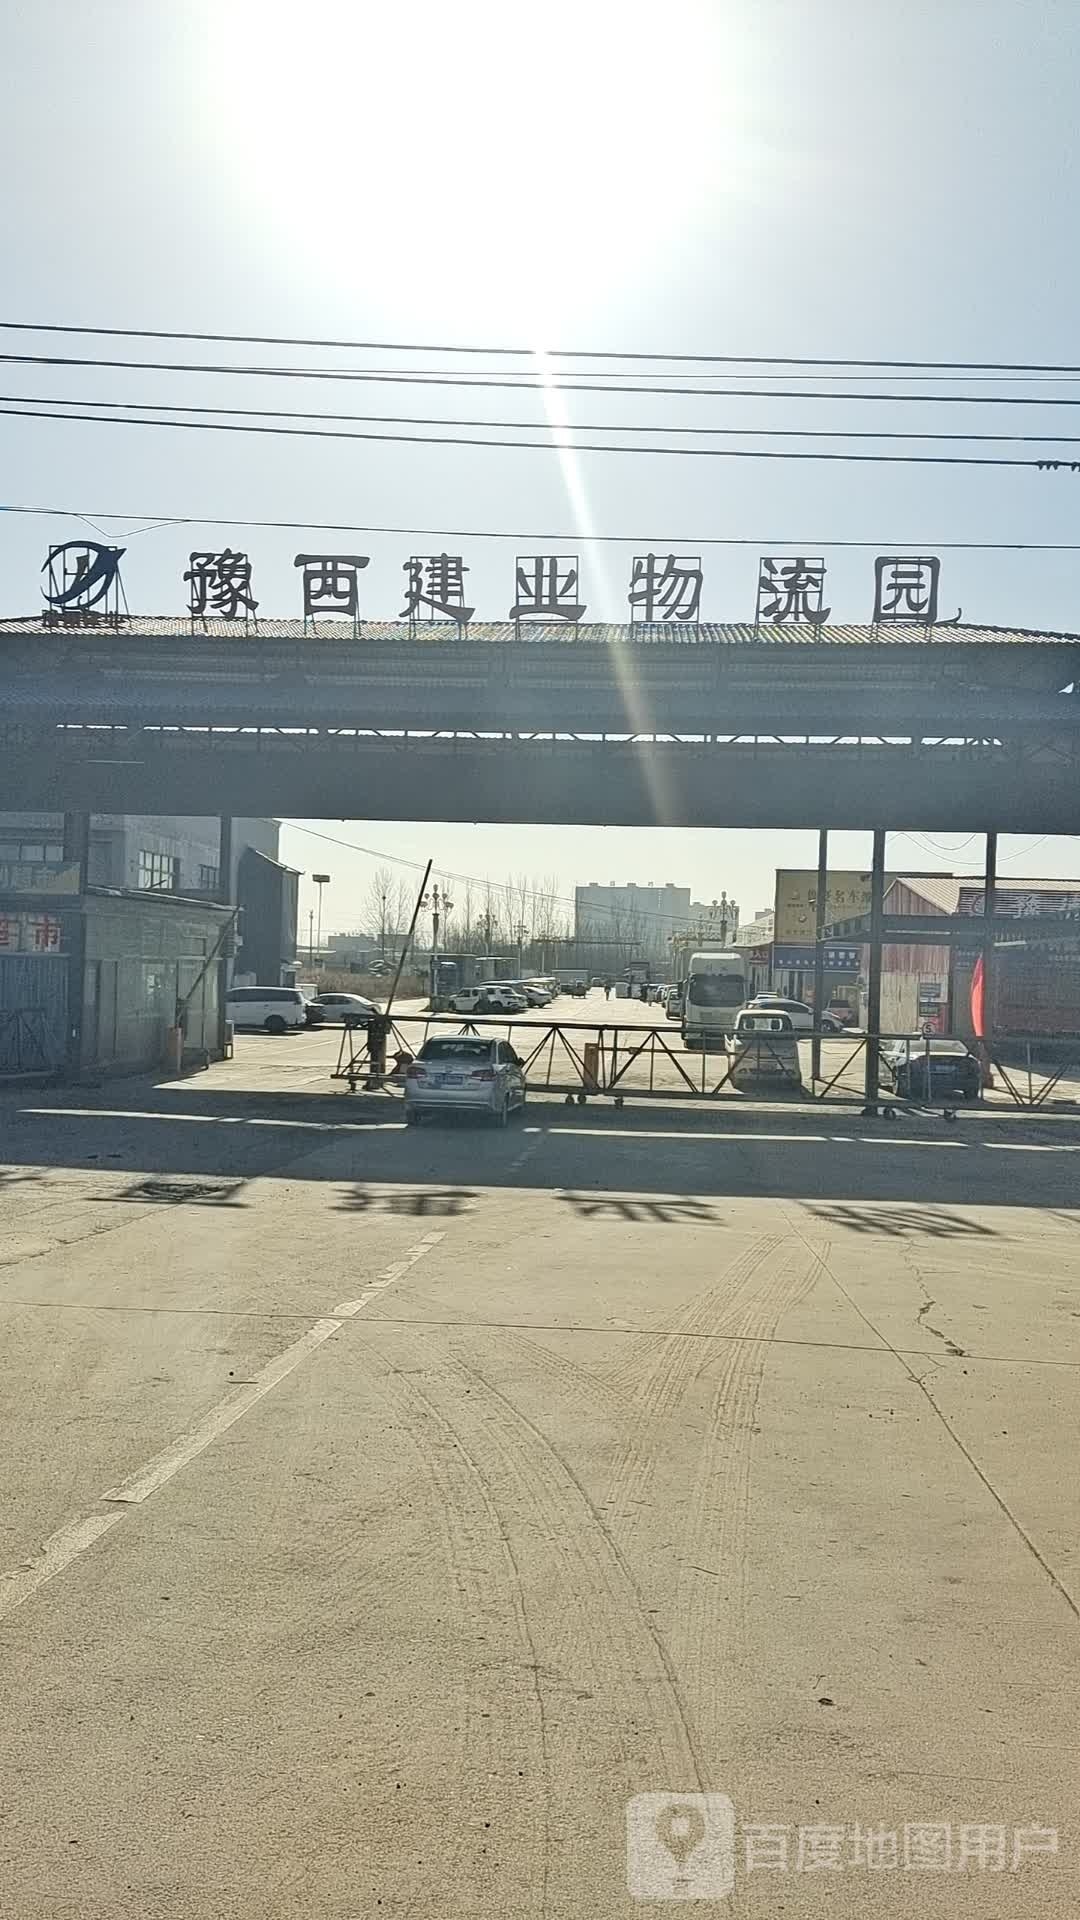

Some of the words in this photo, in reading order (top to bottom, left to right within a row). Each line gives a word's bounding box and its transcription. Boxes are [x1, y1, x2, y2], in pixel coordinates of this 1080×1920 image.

[184, 547, 942, 624] 豫西建业物流园
